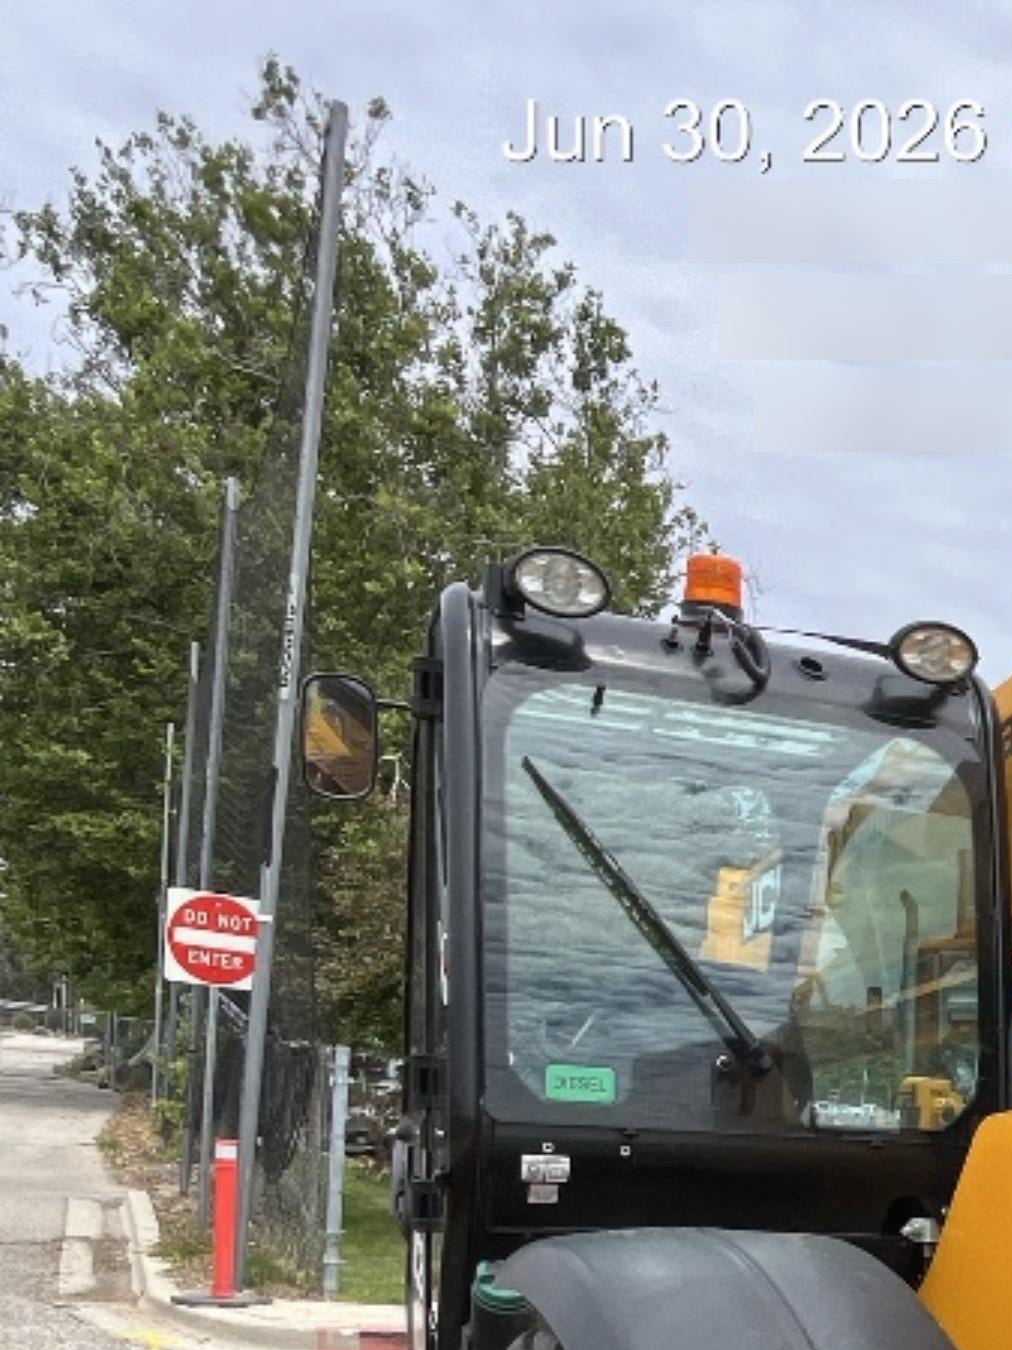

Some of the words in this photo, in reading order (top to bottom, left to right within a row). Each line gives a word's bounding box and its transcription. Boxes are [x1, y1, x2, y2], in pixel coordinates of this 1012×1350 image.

[184, 908, 208, 926] DO
[218, 913, 252, 932] NOT
[187, 948, 244, 971] ENTER
[553, 1075, 608, 1093] DIESEL
